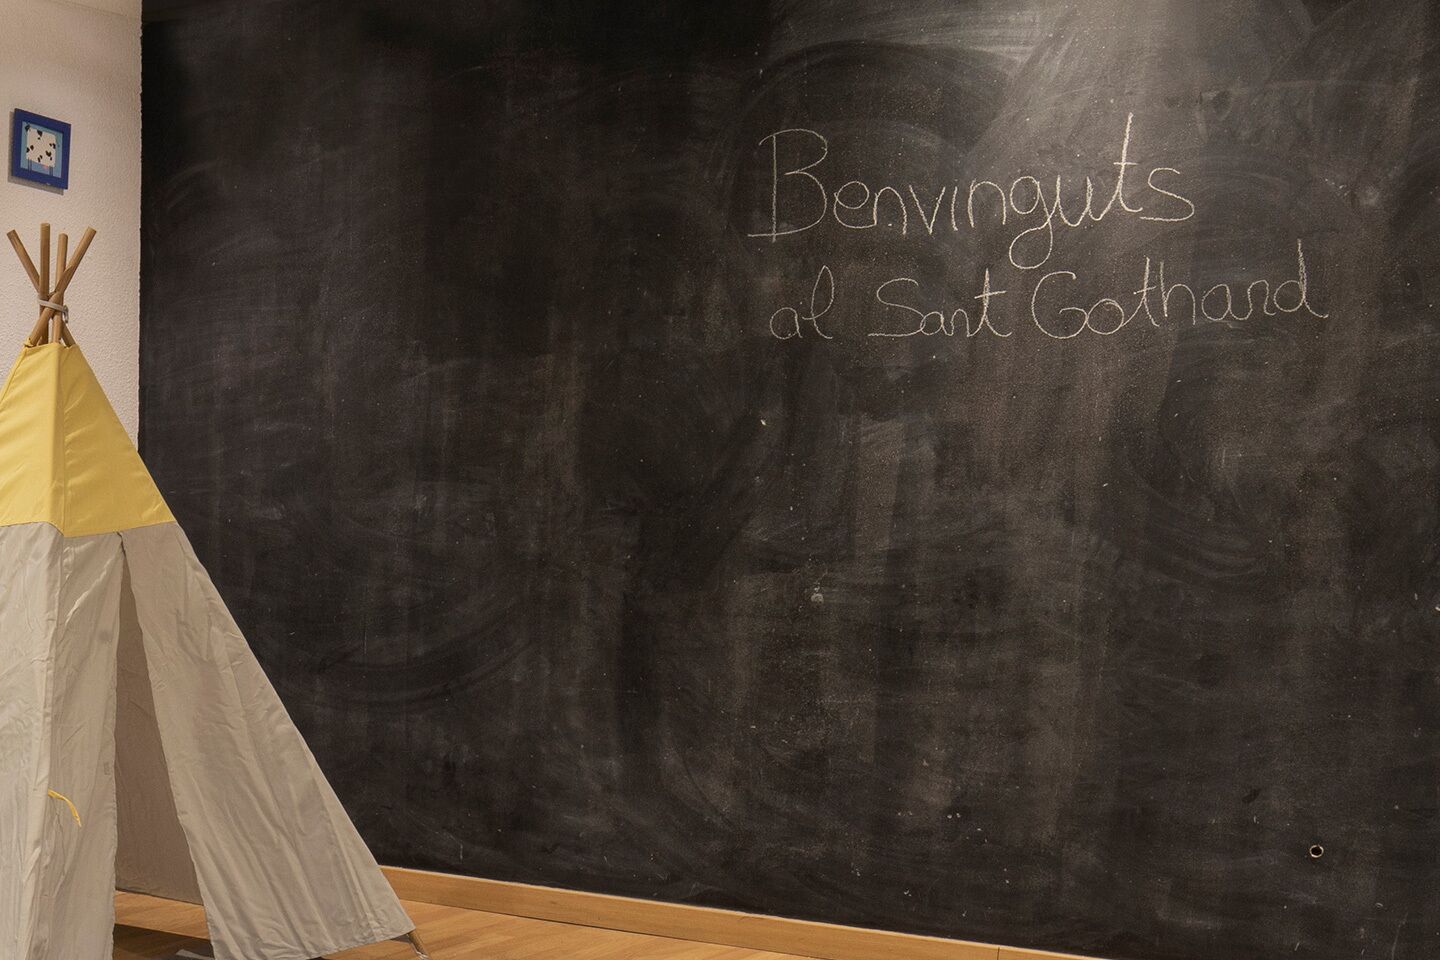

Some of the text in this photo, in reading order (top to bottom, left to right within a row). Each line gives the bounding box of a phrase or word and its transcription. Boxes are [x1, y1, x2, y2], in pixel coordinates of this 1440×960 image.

[747, 112, 1195, 269] Benvinguts
[768, 264, 835, 339] al
[867, 267, 1012, 337] Sant
